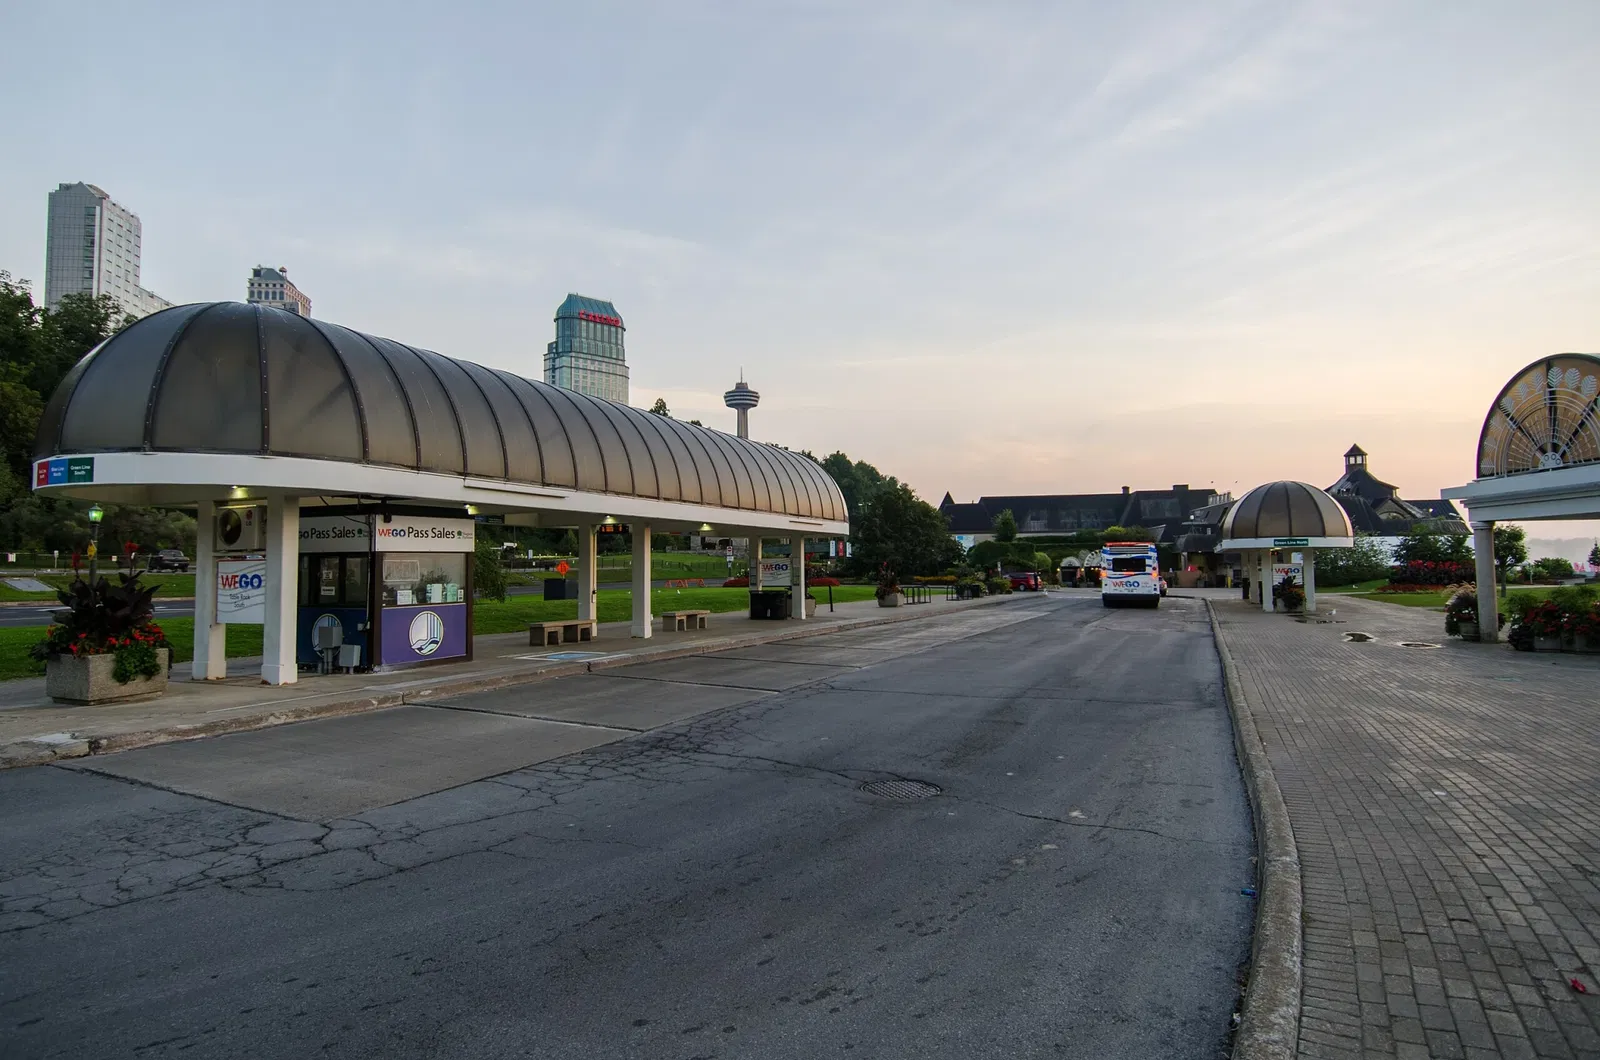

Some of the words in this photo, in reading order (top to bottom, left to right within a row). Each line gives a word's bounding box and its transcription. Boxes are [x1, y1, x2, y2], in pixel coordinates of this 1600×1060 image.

[310, 528, 330, 539] Pass
[332, 526, 356, 539] Sales
[378, 528, 406, 538] WEGO
[408, 526, 429, 538] Pass
[431, 527, 456, 538] Sales
[221, 574, 262, 590] WEGO
